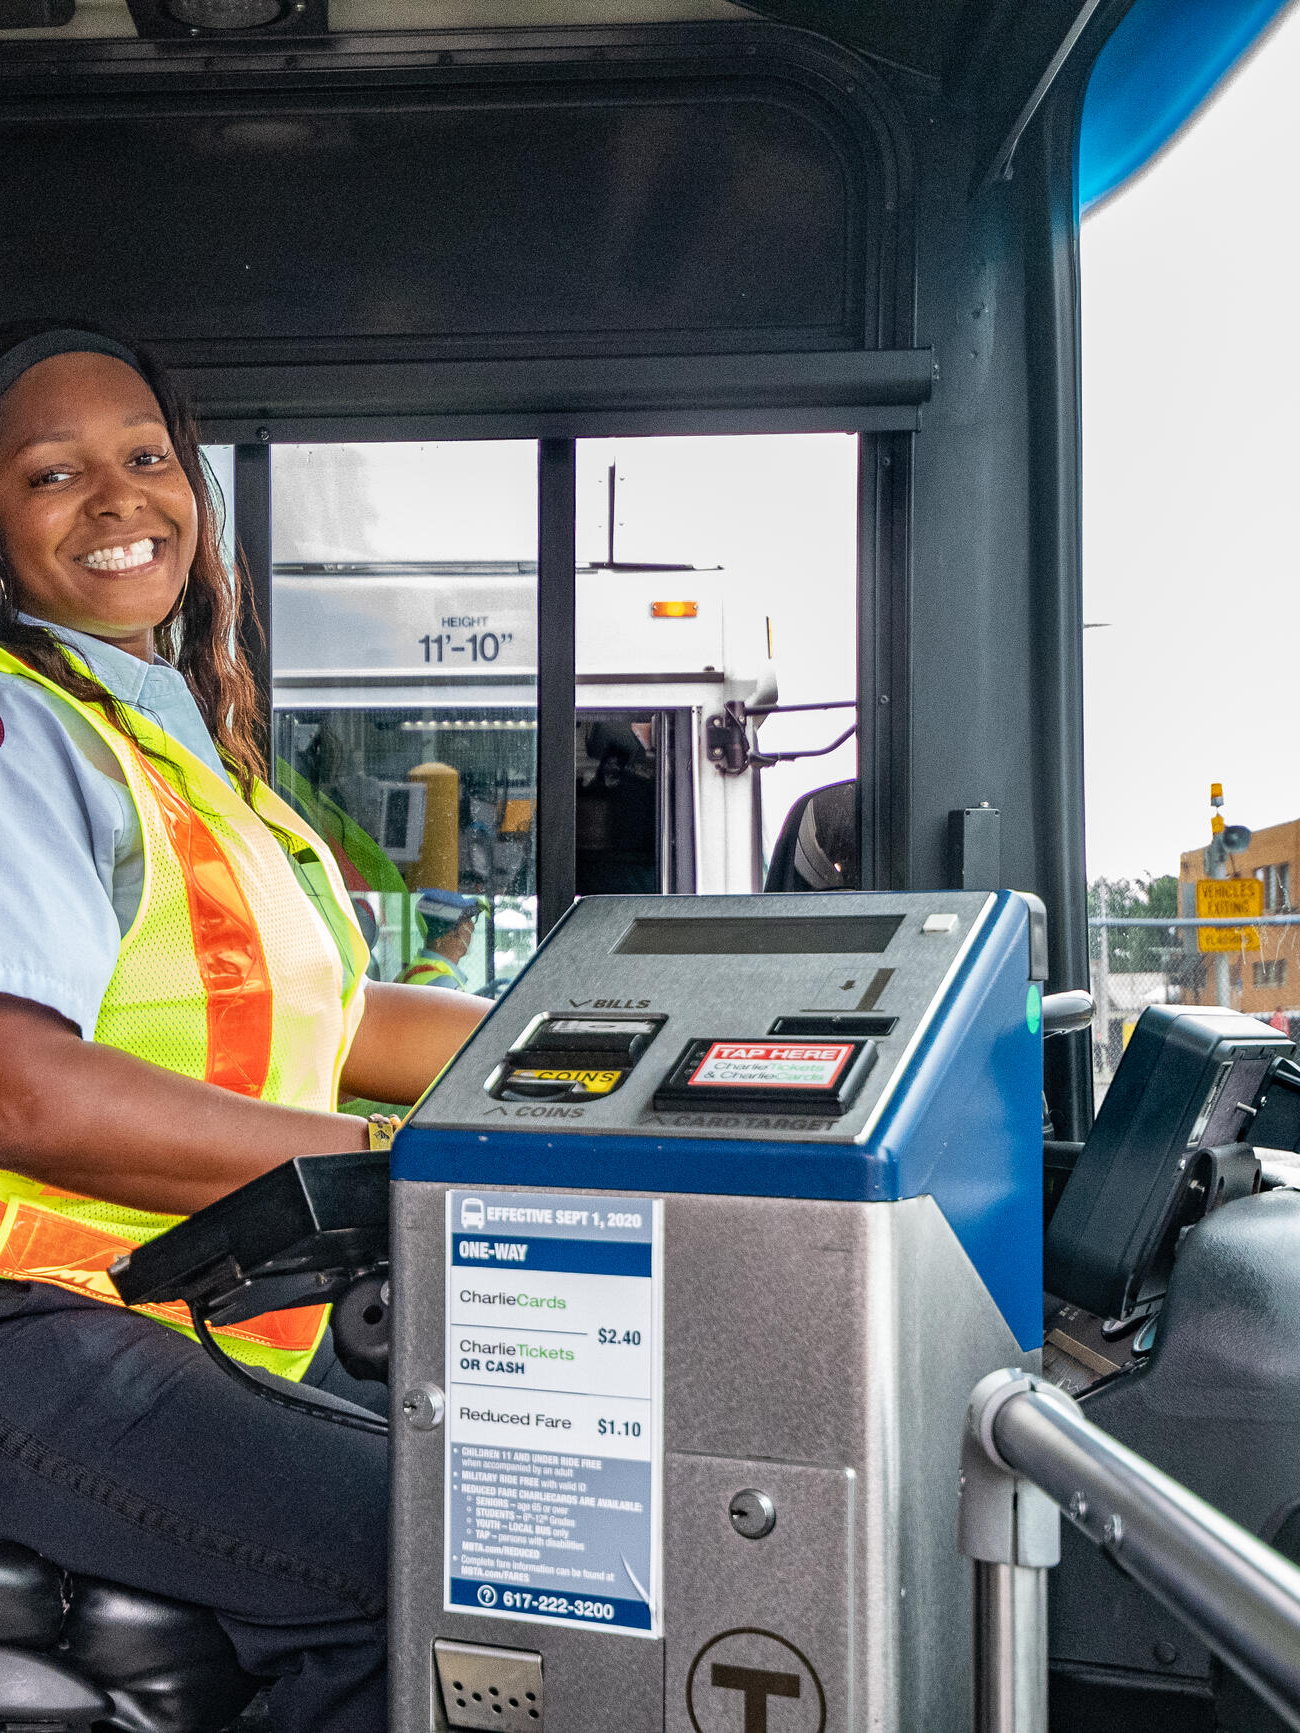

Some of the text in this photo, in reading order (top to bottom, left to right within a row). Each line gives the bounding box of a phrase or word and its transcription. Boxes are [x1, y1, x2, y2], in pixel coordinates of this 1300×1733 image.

[441, 616, 488, 627] HEIGHT
[1202, 882, 1255, 898] VEHICLES
[592, 1000, 651, 1009] BILLS
[717, 1049, 837, 1060] TAP HERE
[703, 1071, 824, 1081] & CharlieCards
[713, 1062, 825, 1072] CharlieTickets
[538, 1072, 615, 1083] COINS
[515, 1106, 585, 1118] COINS
[674, 1115, 840, 1130] CARD TARGET
[487, 1207, 642, 1229] EFFECTIVE SEPT 1, 2020
[459, 1240, 528, 1262] ONE-WAY
[460, 1289, 567, 1309] CharlieCards
[598, 1327, 642, 1346] $2.40
[460, 1339, 575, 1361] CharlieTickets
[460, 1358, 525, 1375] OR CASH
[460, 1406, 572, 1430] Reduced Fare
[598, 1418, 642, 1437] $1.10
[461, 1446, 602, 1470] CHILDREN 11 AND UNDER RIDE FREE
[461, 1458, 574, 1478] when accompanied by an adult
[461, 1470, 498, 1482] MILITARY
[499, 1473, 518, 1484] RIDE
[519, 1475, 539, 1487] FREE
[541, 1479, 557, 1489] with
[558, 1481, 577, 1492] valid
[461, 1483, 643, 1513] REDUCED FARE CHARLIECARDS ARE AVAILABLE:
[475, 1496, 509, 1508] SENIORS
[517, 1502, 531, 1512] age
[531, 1502, 542, 1512] 65
[543, 1504, 551, 1513] or
[552, 1506, 568, 1515] over
[475, 1507, 515, 1520] STUDENTS
[475, 1518, 501, 1529] YOUTH
[509, 1522, 534, 1533] LOCAL
[535, 1524, 552, 1536] BUS
[552, 1528, 570, 1539] only
[475, 1529, 491, 1539] TAP
[498, 1533, 527, 1544] persons
[528, 1536, 544, 1546] with
[545, 1538, 585, 1551] disabilities
[461, 1541, 540, 1559] MBTA.com/REDUCED
[461, 1554, 615, 1581] Complete fare information can be found at
[461, 1565, 530, 1582] MBTA.com/FARES
[503, 1591, 615, 1620] 617-222-3200
[711, 1663, 800, 1733] T
